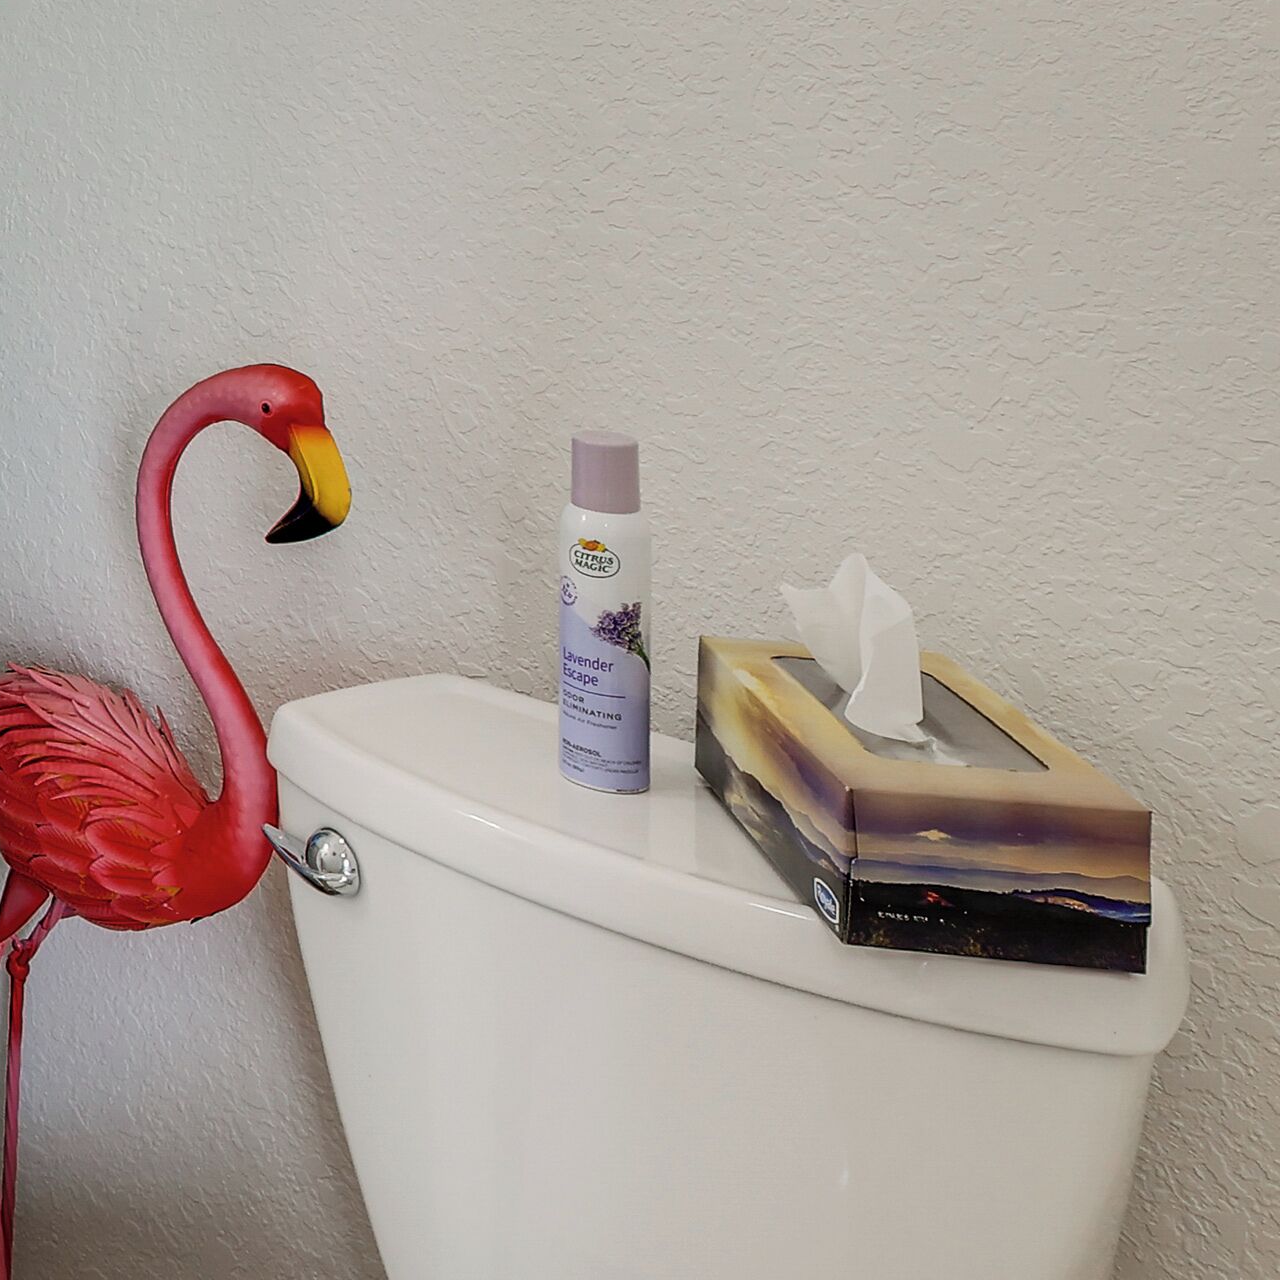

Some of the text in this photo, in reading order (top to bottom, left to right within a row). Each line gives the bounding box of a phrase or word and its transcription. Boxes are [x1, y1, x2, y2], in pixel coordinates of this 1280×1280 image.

[574, 550, 614, 565] CITRUS
[575, 559, 610, 573] MAGIC
[563, 647, 614, 673] Lavender
[563, 662, 599, 686] Escape
[563, 689, 585, 704] ODOR
[563, 698, 622, 721] ELIMINATING
